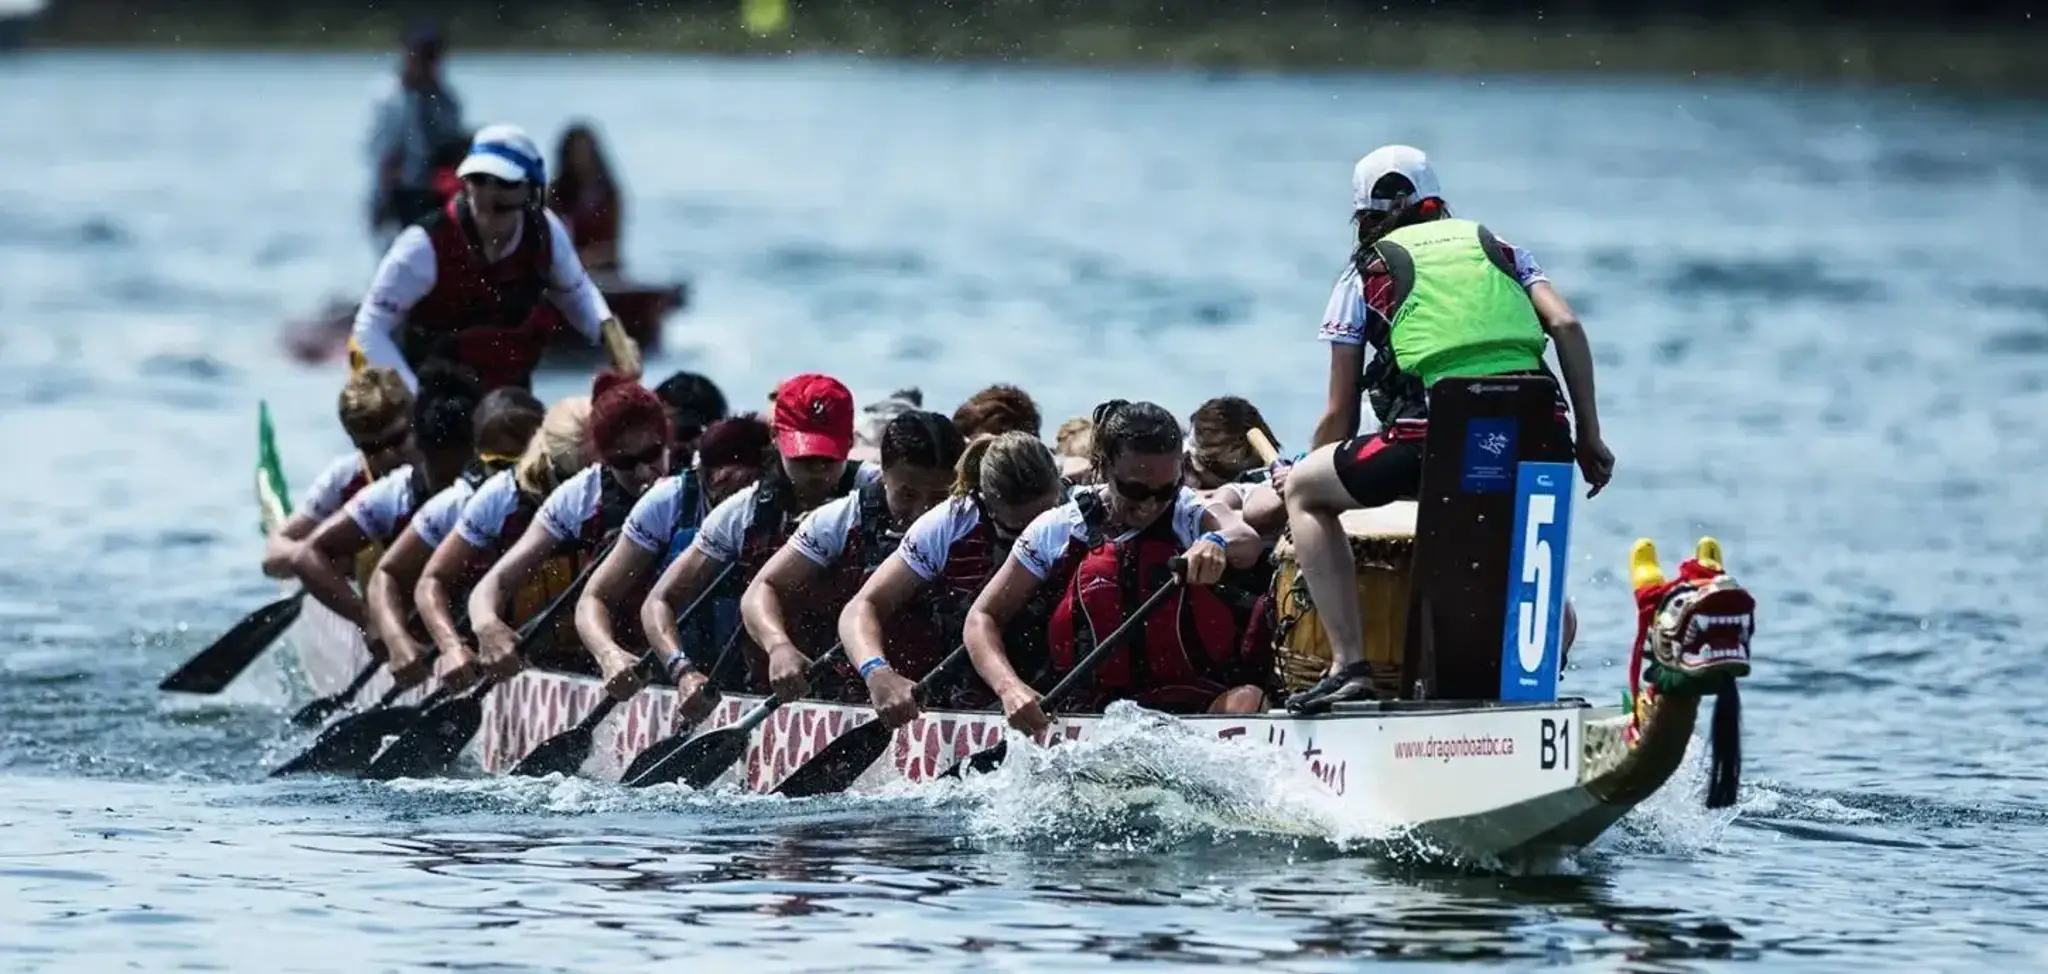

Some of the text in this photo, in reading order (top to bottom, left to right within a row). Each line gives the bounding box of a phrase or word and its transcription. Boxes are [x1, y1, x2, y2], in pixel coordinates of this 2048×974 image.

[1518, 494, 1556, 672] 5
[1394, 735, 1514, 763] www.dragonboatbc.ca
[1541, 718, 1569, 770] B1
